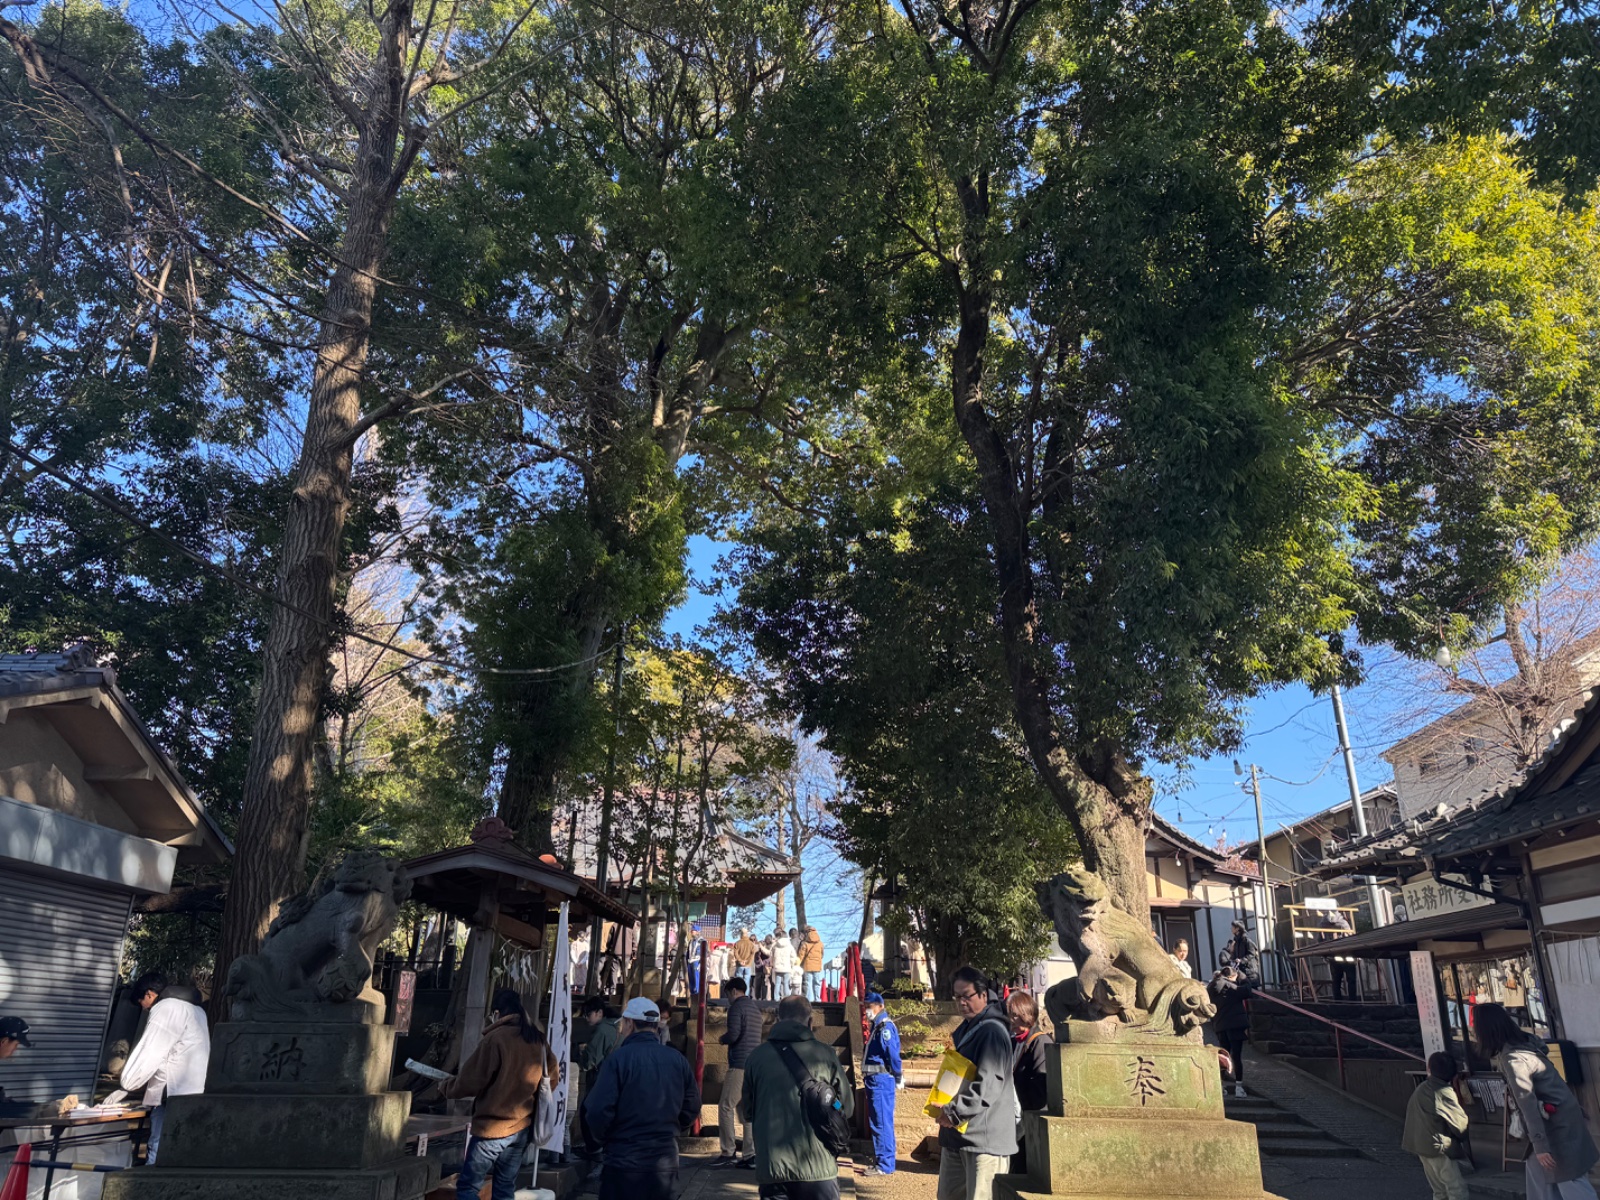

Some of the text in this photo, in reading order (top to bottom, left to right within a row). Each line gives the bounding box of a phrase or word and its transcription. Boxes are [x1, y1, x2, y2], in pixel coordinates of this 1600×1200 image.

[1407, 876, 1487, 914] 社務所受
[260, 1037, 307, 1081] 納
[1124, 1056, 1166, 1106] 奉
